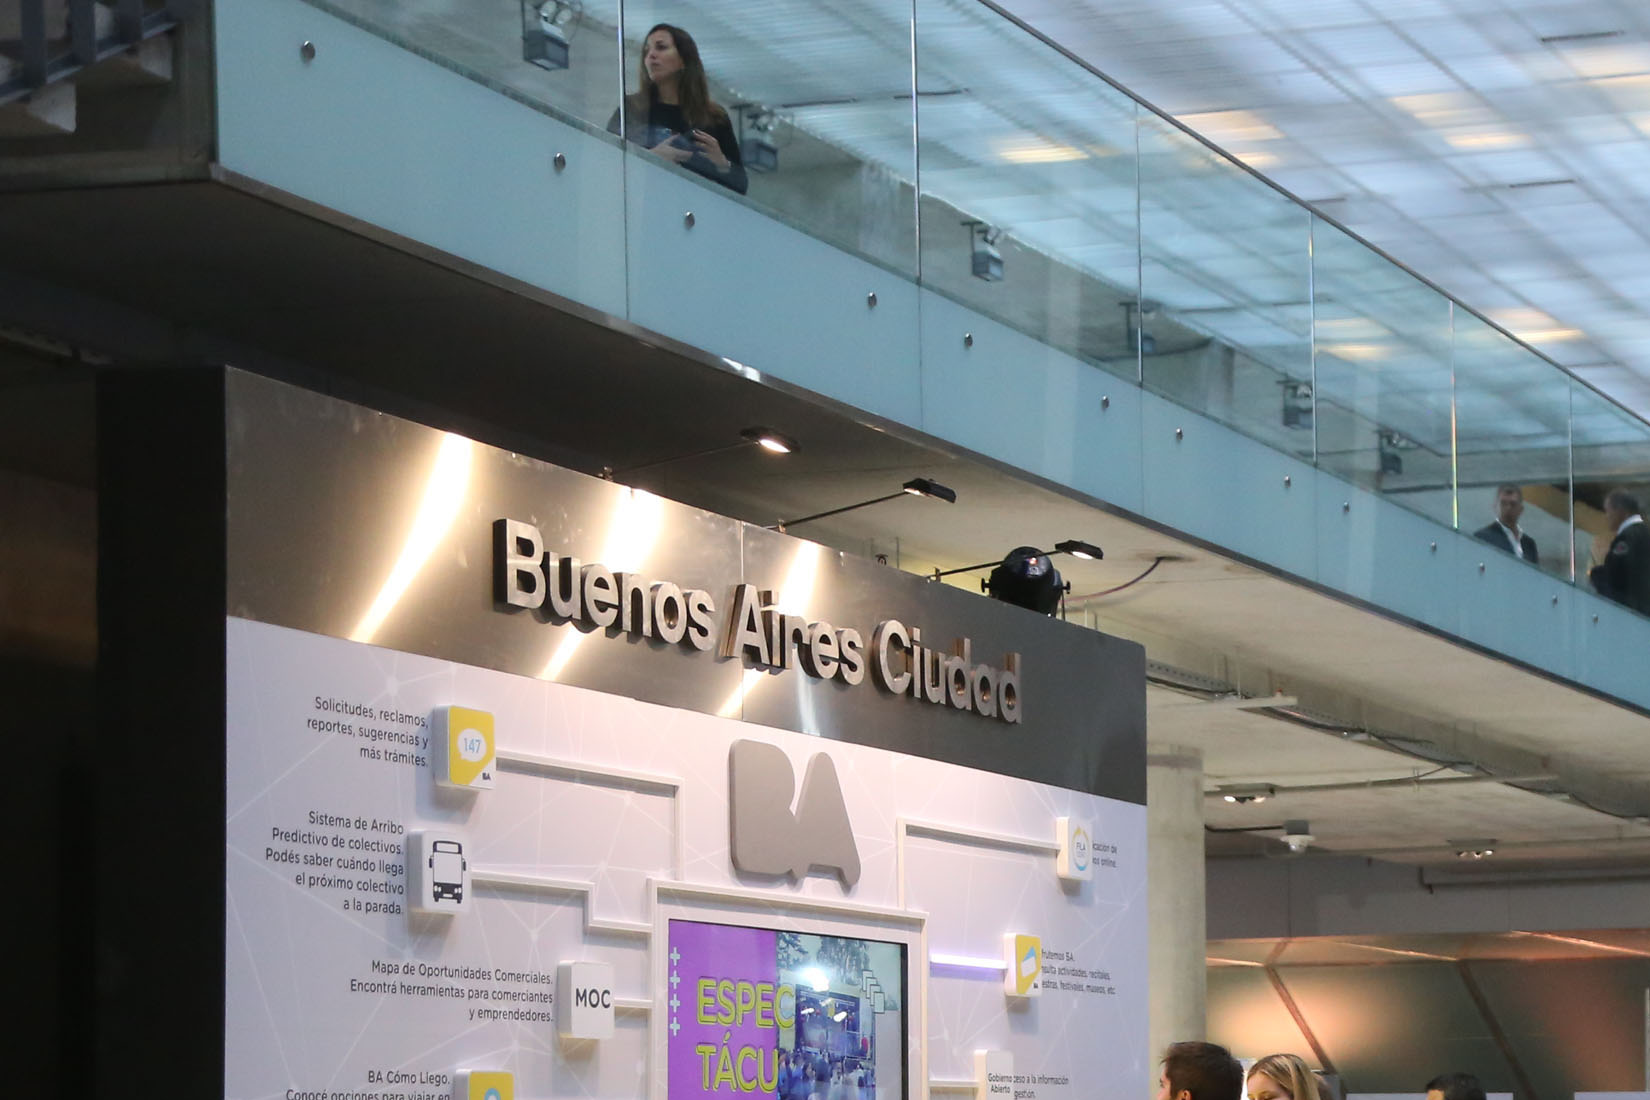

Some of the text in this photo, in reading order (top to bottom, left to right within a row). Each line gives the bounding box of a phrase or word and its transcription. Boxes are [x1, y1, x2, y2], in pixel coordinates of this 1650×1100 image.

[493, 518, 1022, 724] Buenos Aires Ciudad
[315, 696, 429, 729] Solicitudes, reclamos,
[307, 718, 429, 750] reportes, sugerencias y
[463, 737, 482, 753] 147
[360, 745, 429, 768] más trámites.
[309, 810, 404, 835] Sistema de Arribo
[272, 827, 404, 855] Predictivo de colectivos.
[265, 847, 404, 877] Podés saber cuándo llega
[295, 872, 404, 895] el próximo colectivo
[343, 897, 404, 915] a la parada.
[372, 959, 553, 985] Mapa de Oportunidades Comerciales.
[350, 979, 553, 1004] Encontrá herramientas para comerciantes
[575, 988, 611, 1009] MOC
[696, 977, 796, 1029] ESPEC
[469, 1006, 554, 1023] y emprendedores.
[695, 1030, 779, 1093] TÁCU
[368, 1070, 450, 1087] BA Cómo Llego.
[988, 1072, 1012, 1083] Gobierno
[991, 1084, 1011, 1093] Abierto
[1013, 1075, 1025, 1084] ceso
